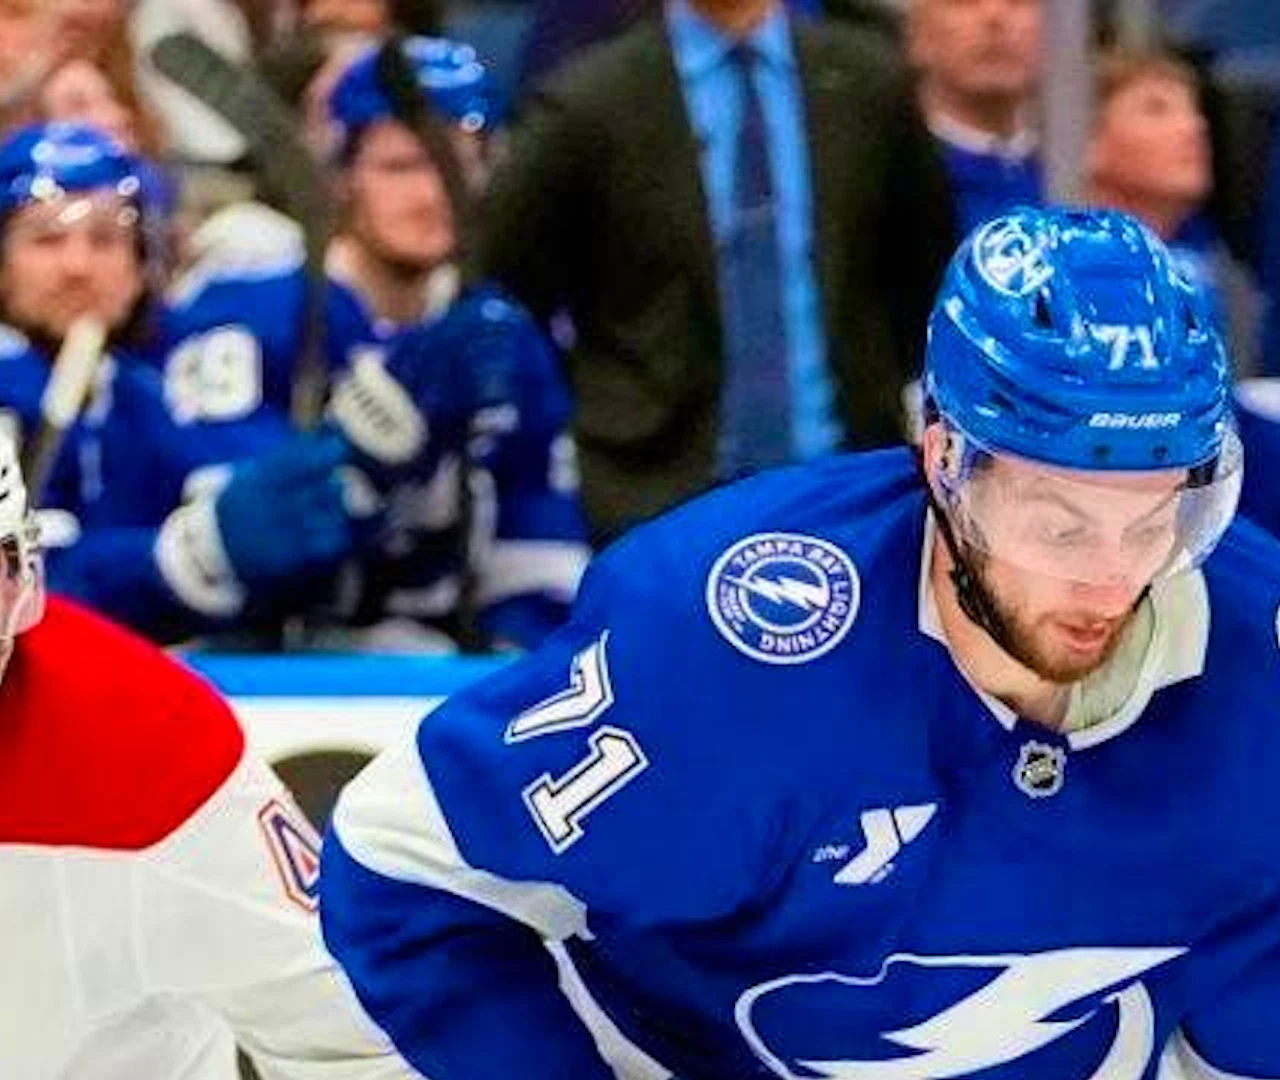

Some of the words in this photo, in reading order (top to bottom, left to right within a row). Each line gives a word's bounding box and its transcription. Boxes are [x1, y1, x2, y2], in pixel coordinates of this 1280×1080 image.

[1088, 322, 1160, 371] 71
[1088, 412, 1182, 430] BAUER
[729, 541, 805, 570] TAMPA
[806, 548, 845, 576] BAY
[758, 579, 849, 653] LIGHTNING
[503, 629, 650, 856] 71
